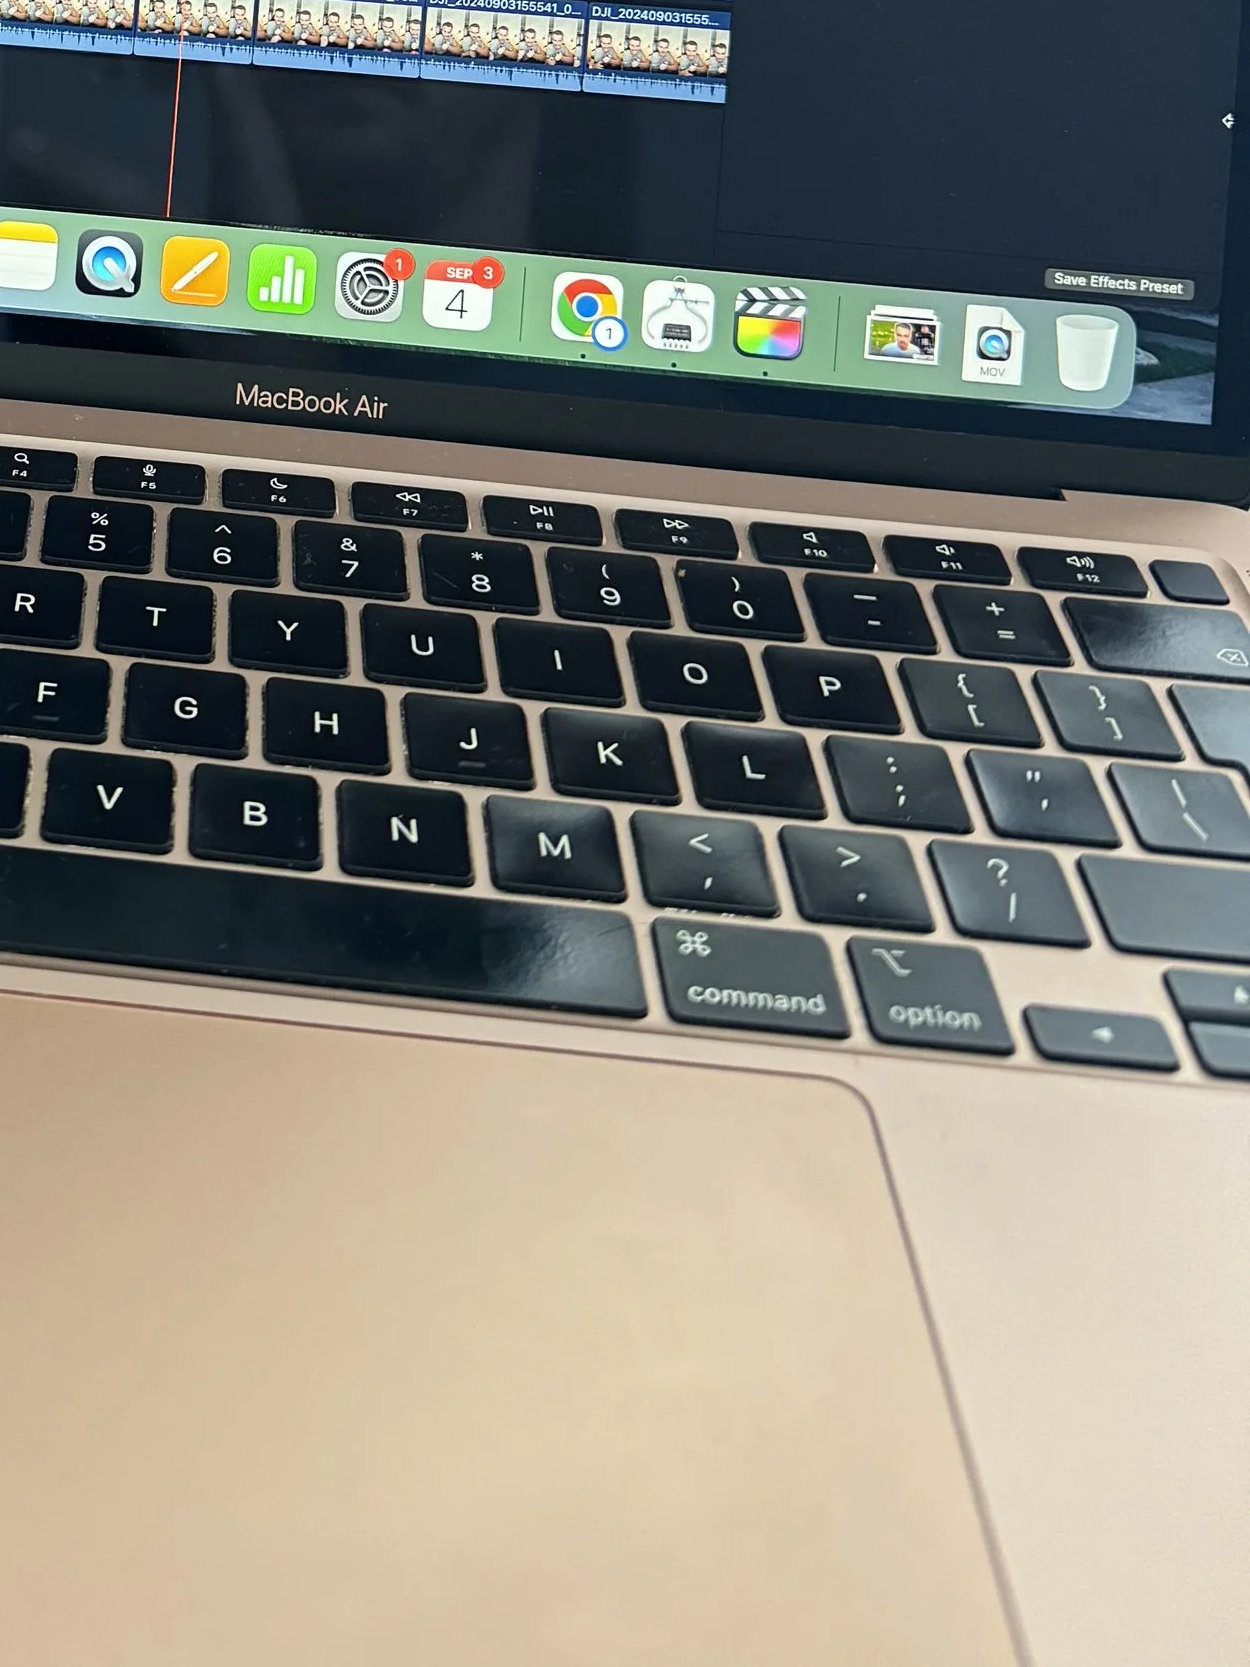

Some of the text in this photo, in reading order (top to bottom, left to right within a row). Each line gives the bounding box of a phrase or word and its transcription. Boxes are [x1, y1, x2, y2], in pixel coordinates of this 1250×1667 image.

[395, 258, 403, 272] 1
[446, 266, 473, 280] SEP
[483, 266, 493, 281] 3
[1054, 272, 1183, 295] Save Effects Preset
[445, 290, 468, 319] 4
[980, 367, 1005, 377] MOV
[236, 383, 388, 420] MacBook Air
[11, 469, 27, 478] F4
[141, 480, 157, 490] F5
[271, 493, 287, 503] F6
[402, 507, 418, 517] F7
[536, 521, 553, 531] F8
[87, 534, 107, 553] 5
[671, 535, 689, 545] F9
[212, 546, 232, 565] 6
[804, 548, 827, 558] F10
[341, 559, 360, 578] 7
[471, 573, 491, 593] 8
[15, 592, 36, 615] R
[600, 587, 621, 606] 9
[146, 606, 166, 628] T
[732, 599, 754, 620] 0
[277, 620, 299, 642] Y
[410, 634, 435, 657] U
[37, 682, 58, 705] F
[819, 675, 841, 697] P
[173, 696, 199, 720] G
[313, 711, 340, 735] H
[458, 728, 479, 752] J
[597, 742, 623, 767] K
[741, 756, 766, 780] L
[96, 785, 124, 811] V
[243, 801, 269, 826] B
[391, 818, 418, 843] N
[538, 833, 571, 860] M
[686, 983, 826, 1016] command
[889, 1002, 983, 1031] option
